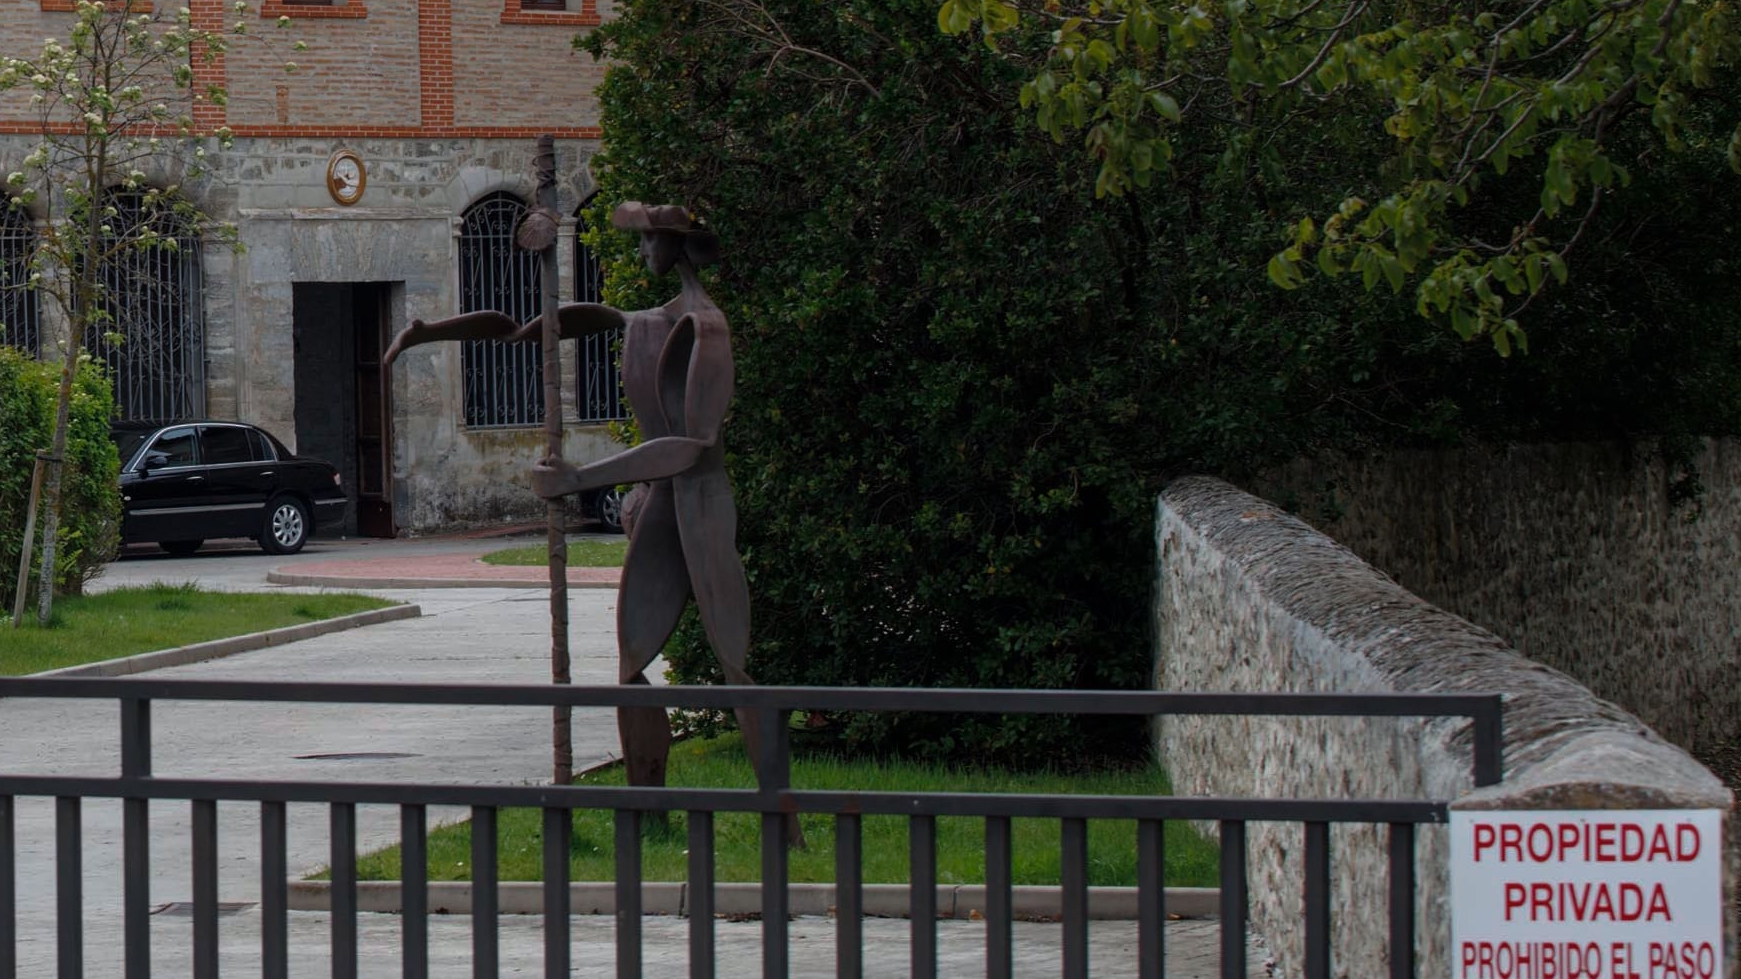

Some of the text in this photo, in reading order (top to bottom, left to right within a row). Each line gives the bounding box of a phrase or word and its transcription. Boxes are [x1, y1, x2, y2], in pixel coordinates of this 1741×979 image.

[1473, 823, 1701, 862] PROPIEDAD
[1504, 883, 1672, 922] PRIVADA
[1461, 941, 1716, 979] PROHIBIDO EL PASO
